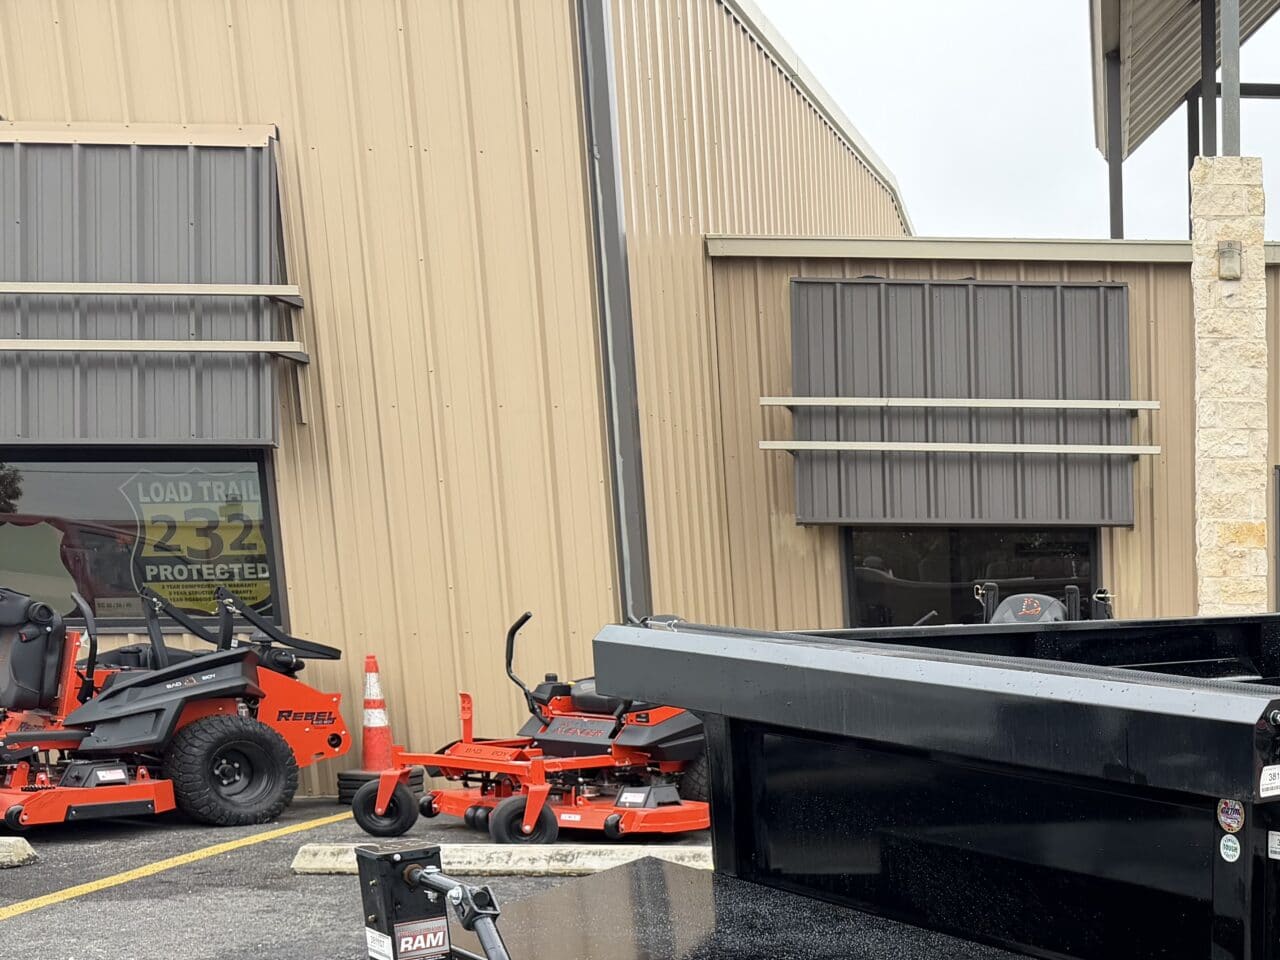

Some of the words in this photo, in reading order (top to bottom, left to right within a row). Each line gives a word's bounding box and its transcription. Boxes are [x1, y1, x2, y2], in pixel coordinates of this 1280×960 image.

[137, 481, 192, 502] LOAD
[198, 480, 262, 502] TRAIL
[151, 508, 258, 560] 232
[145, 563, 270, 581] PROTECTED
[399, 931, 444, 953] RAM
